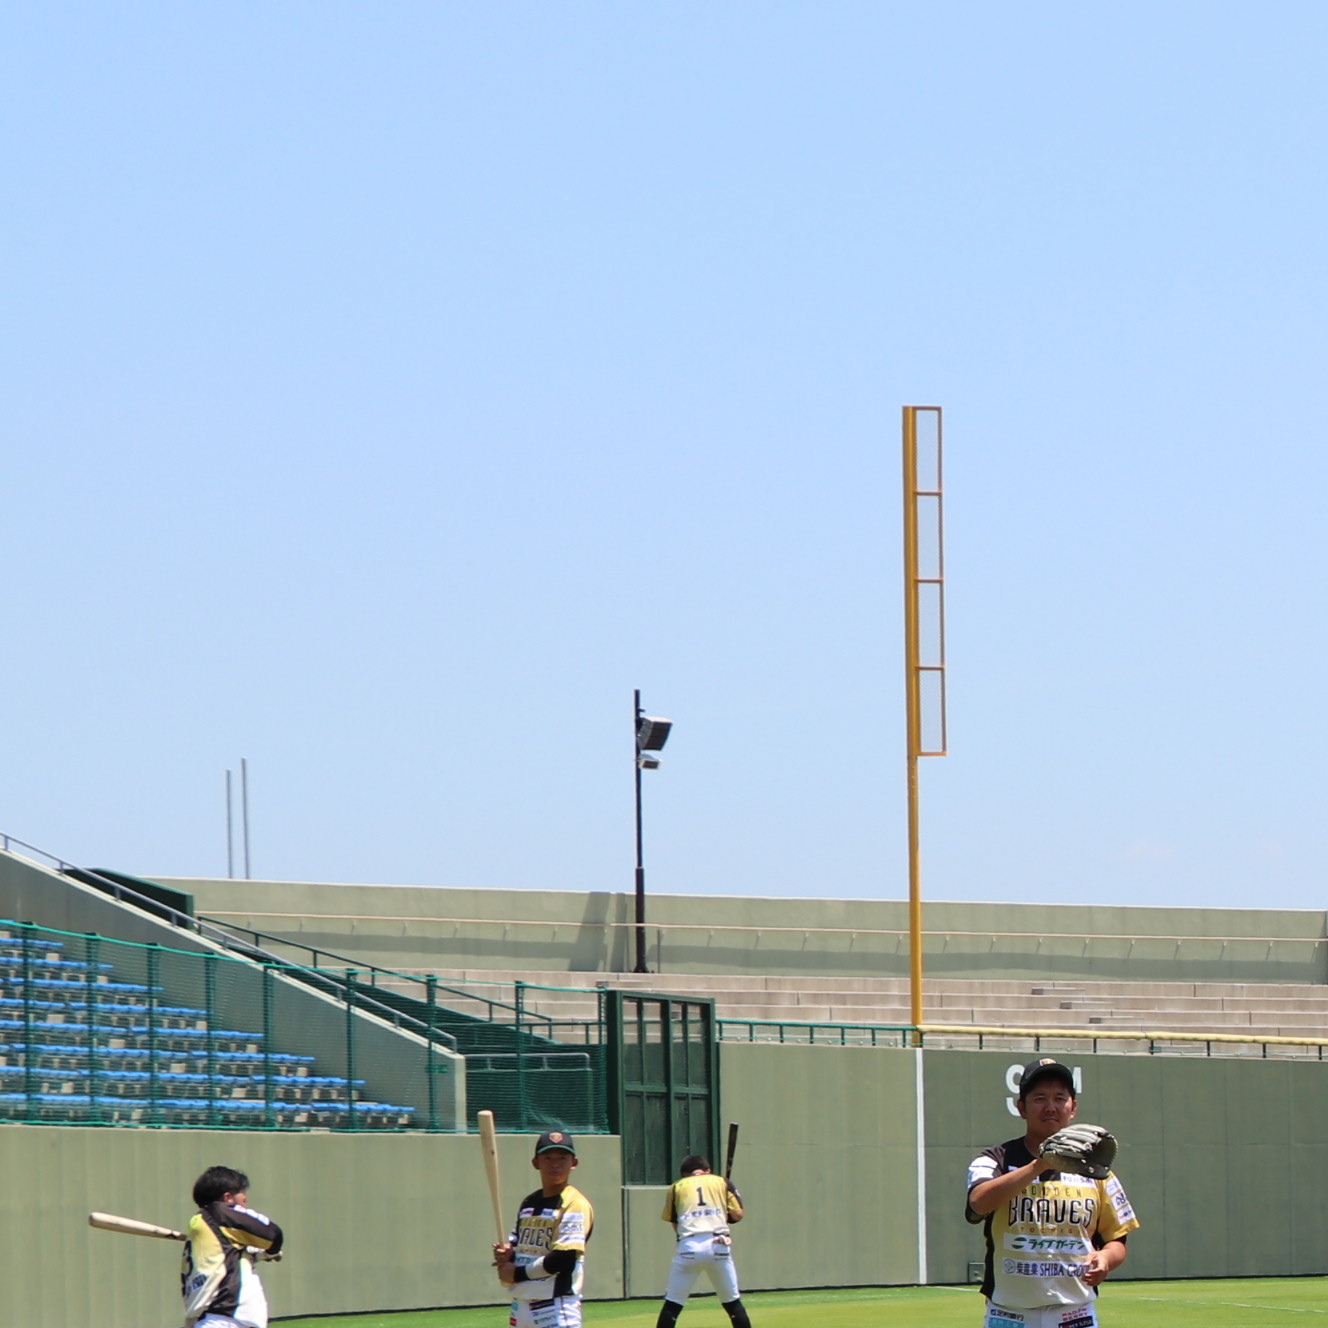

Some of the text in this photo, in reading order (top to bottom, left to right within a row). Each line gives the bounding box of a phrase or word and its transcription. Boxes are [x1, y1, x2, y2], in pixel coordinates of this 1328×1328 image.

[696, 1186, 707, 1206] 1
[1008, 1195, 1095, 1228] BRAVES
[1040, 1262, 1065, 1276] SHIBA
